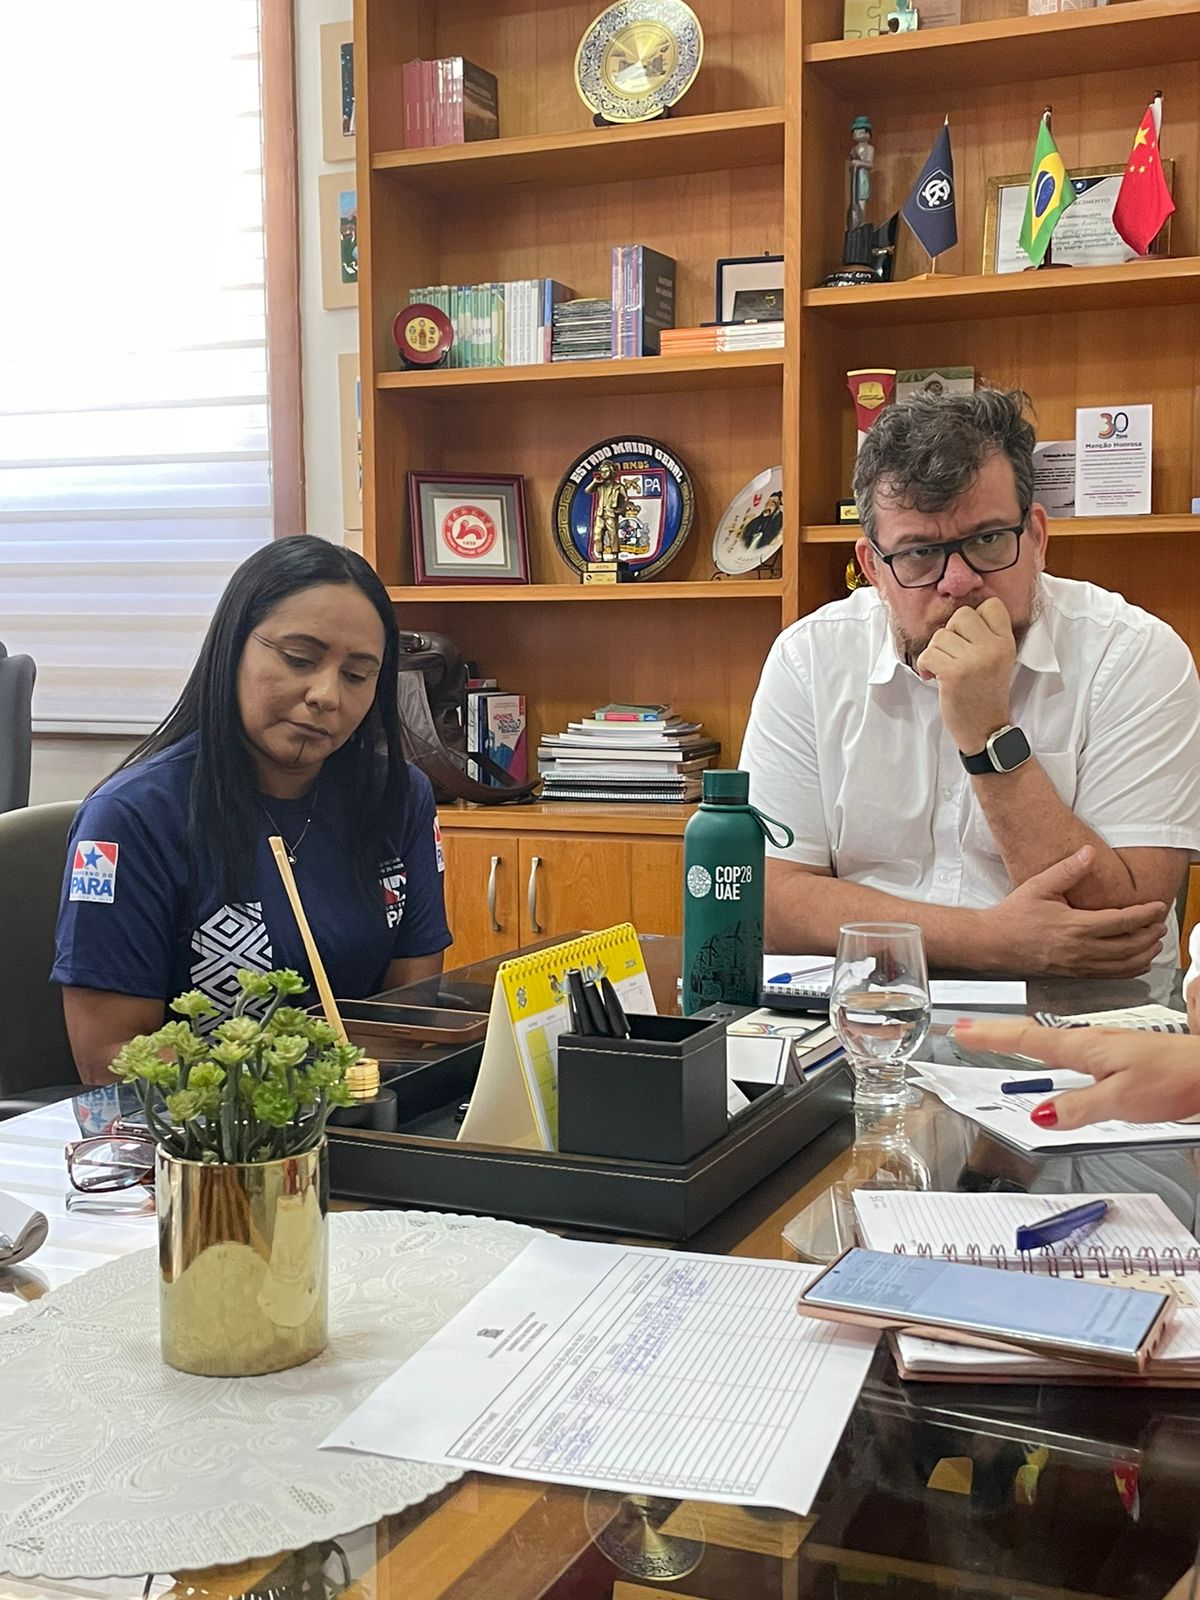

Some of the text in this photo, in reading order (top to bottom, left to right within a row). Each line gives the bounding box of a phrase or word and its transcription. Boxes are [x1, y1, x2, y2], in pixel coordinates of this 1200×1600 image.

[1098, 412, 1129, 439] 30
[570, 442, 683, 483] ESTADO MAIOR GERAL
[644, 477, 661, 493] PA
[715, 865, 752, 883] COP28
[715, 883, 741, 900] UAE
